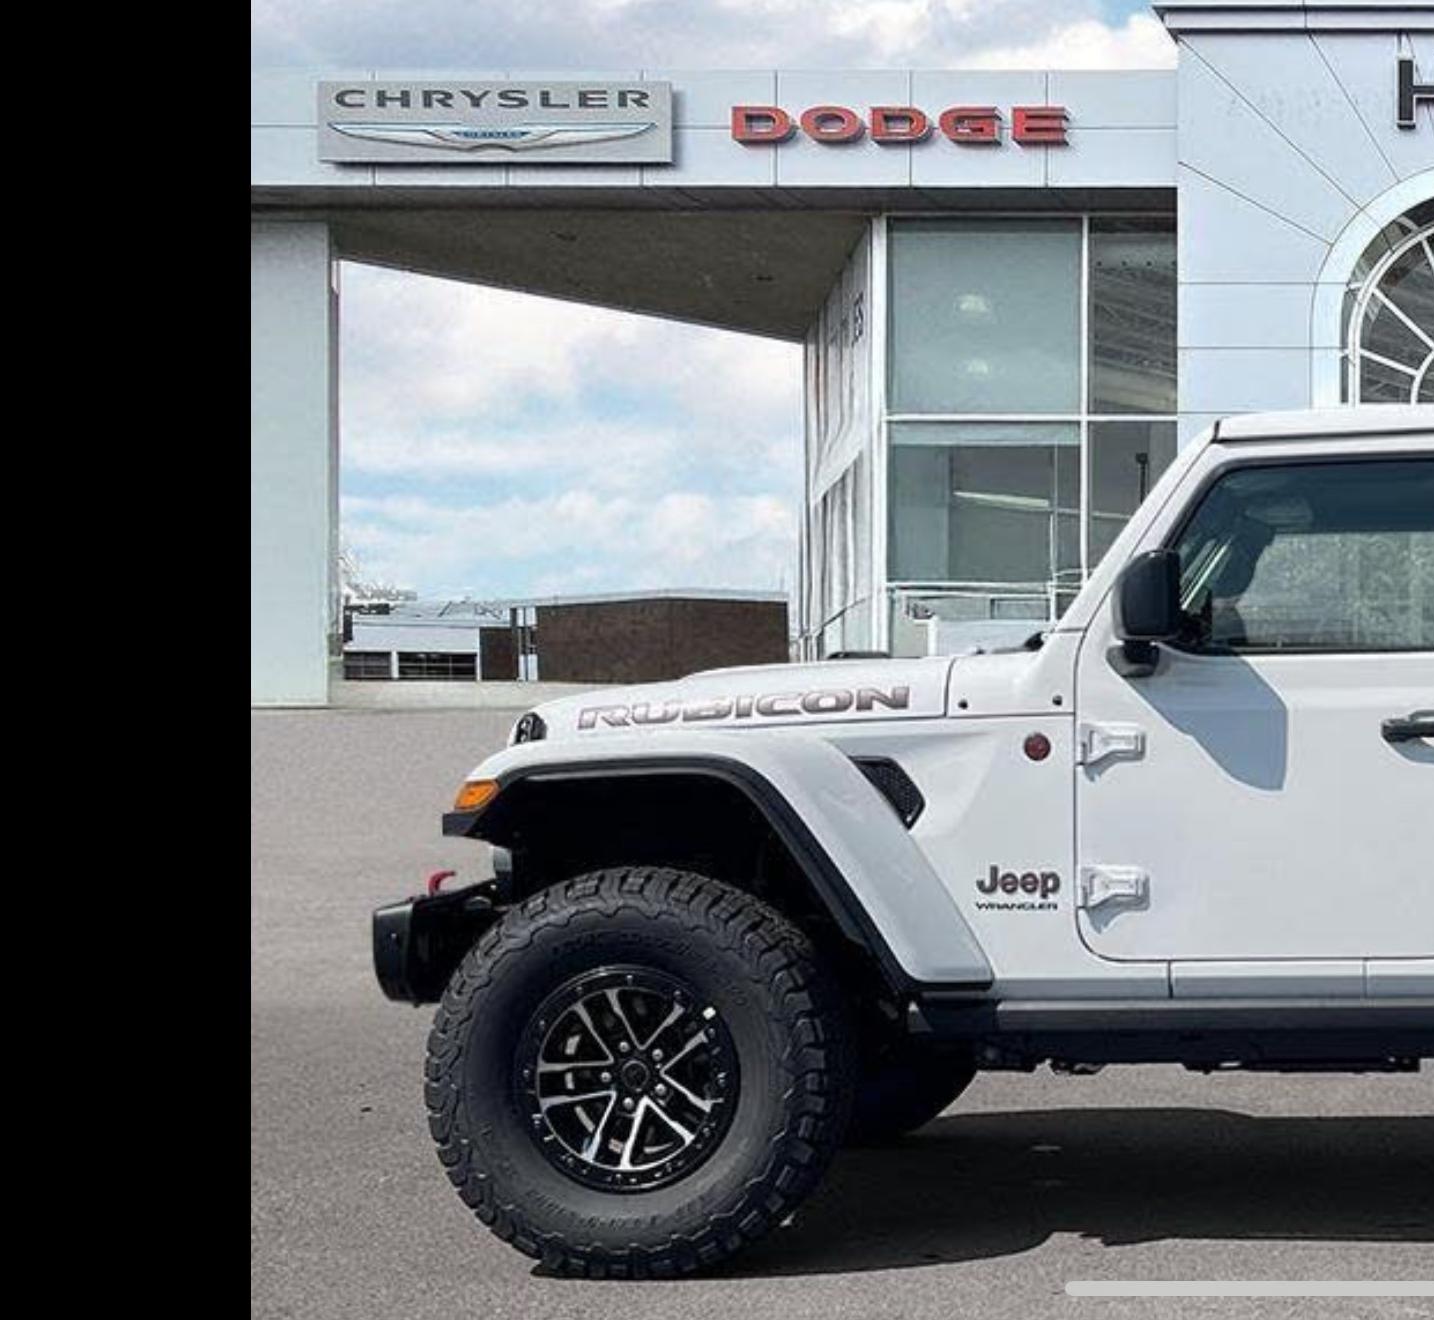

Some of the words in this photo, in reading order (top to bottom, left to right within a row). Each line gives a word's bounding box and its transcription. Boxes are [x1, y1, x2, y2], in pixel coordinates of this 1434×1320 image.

[335, 89, 651, 110] CHRYSLER
[731, 105, 1071, 146] DODGE
[578, 686, 909, 730] RUBICON
[976, 865, 1061, 899] Jeep
